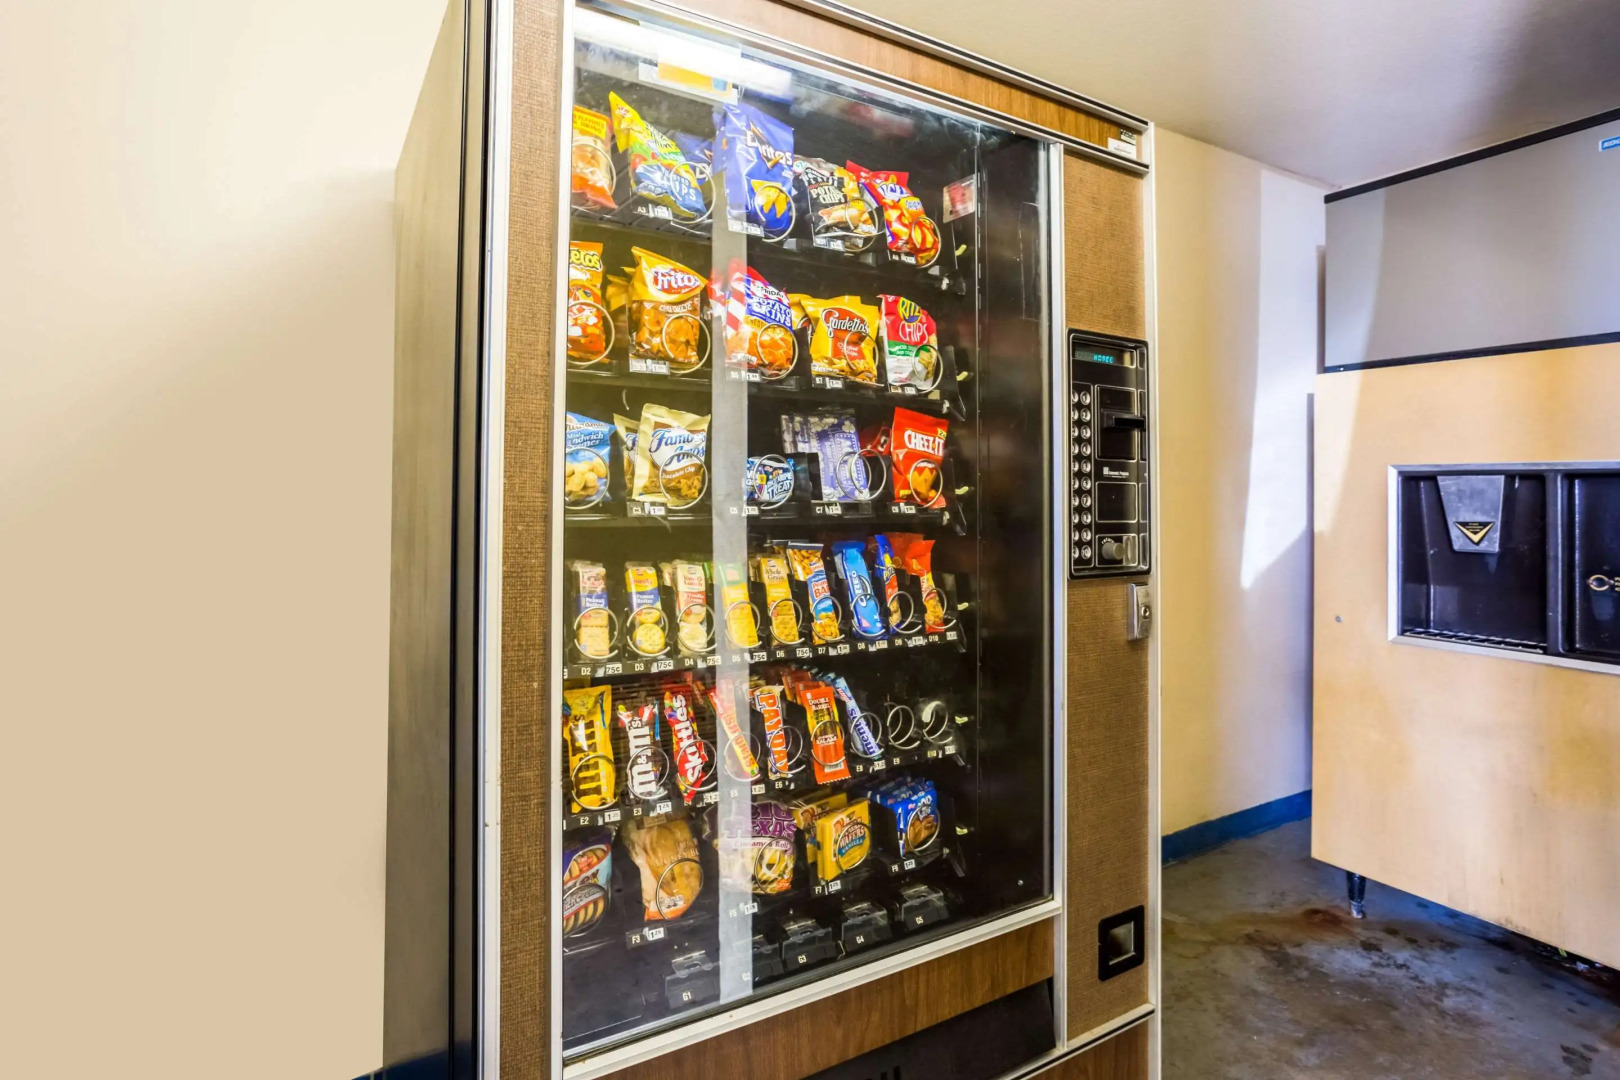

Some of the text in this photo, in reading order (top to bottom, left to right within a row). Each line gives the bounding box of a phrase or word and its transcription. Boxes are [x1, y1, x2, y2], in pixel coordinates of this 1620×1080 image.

[821, 308, 869, 338] Gardetto's
[899, 321, 928, 344] CHIPS
[685, 658, 694, 666] D4
[634, 663, 644, 671] D3
[581, 668, 591, 676] D2
[632, 935, 640, 944] F3
[682, 991, 692, 1001] G1
